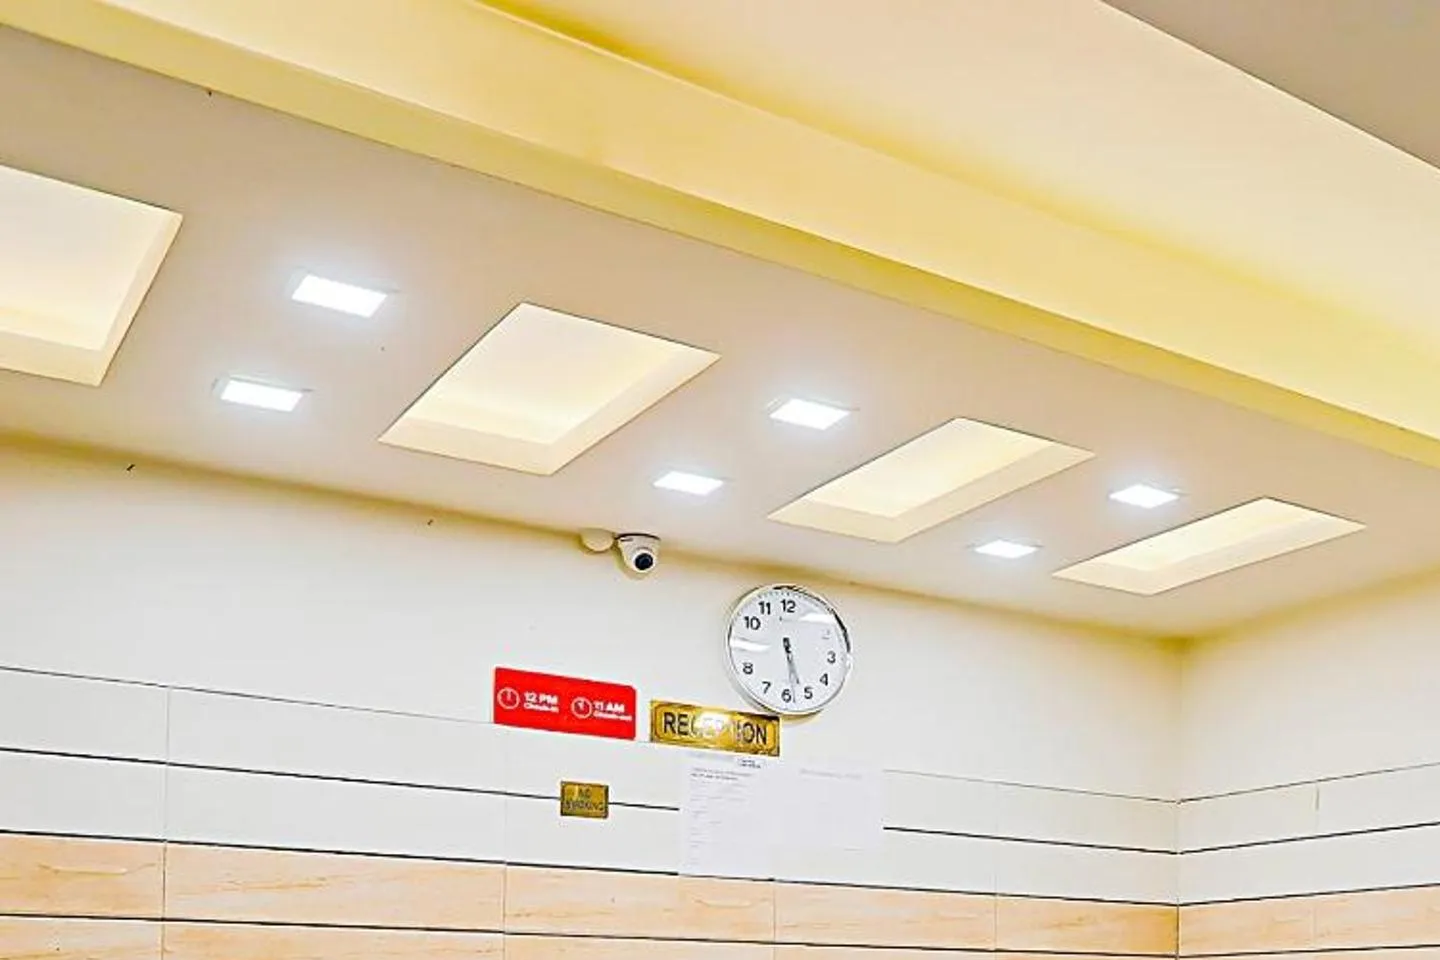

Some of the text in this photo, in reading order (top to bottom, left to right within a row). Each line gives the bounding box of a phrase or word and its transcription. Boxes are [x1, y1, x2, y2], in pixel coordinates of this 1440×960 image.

[759, 601, 771, 615] 11
[781, 599, 796, 613] 12
[744, 616, 760, 630] 10
[827, 651, 836, 664] 3
[742, 662, 753, 675] 8
[820, 673, 828, 686] 4
[762, 681, 771, 694] 7
[804, 686, 813, 700] 5
[524, 691, 558, 704] 12 PM
[781, 689, 792, 703] 6
[606, 701, 625, 713] AM
